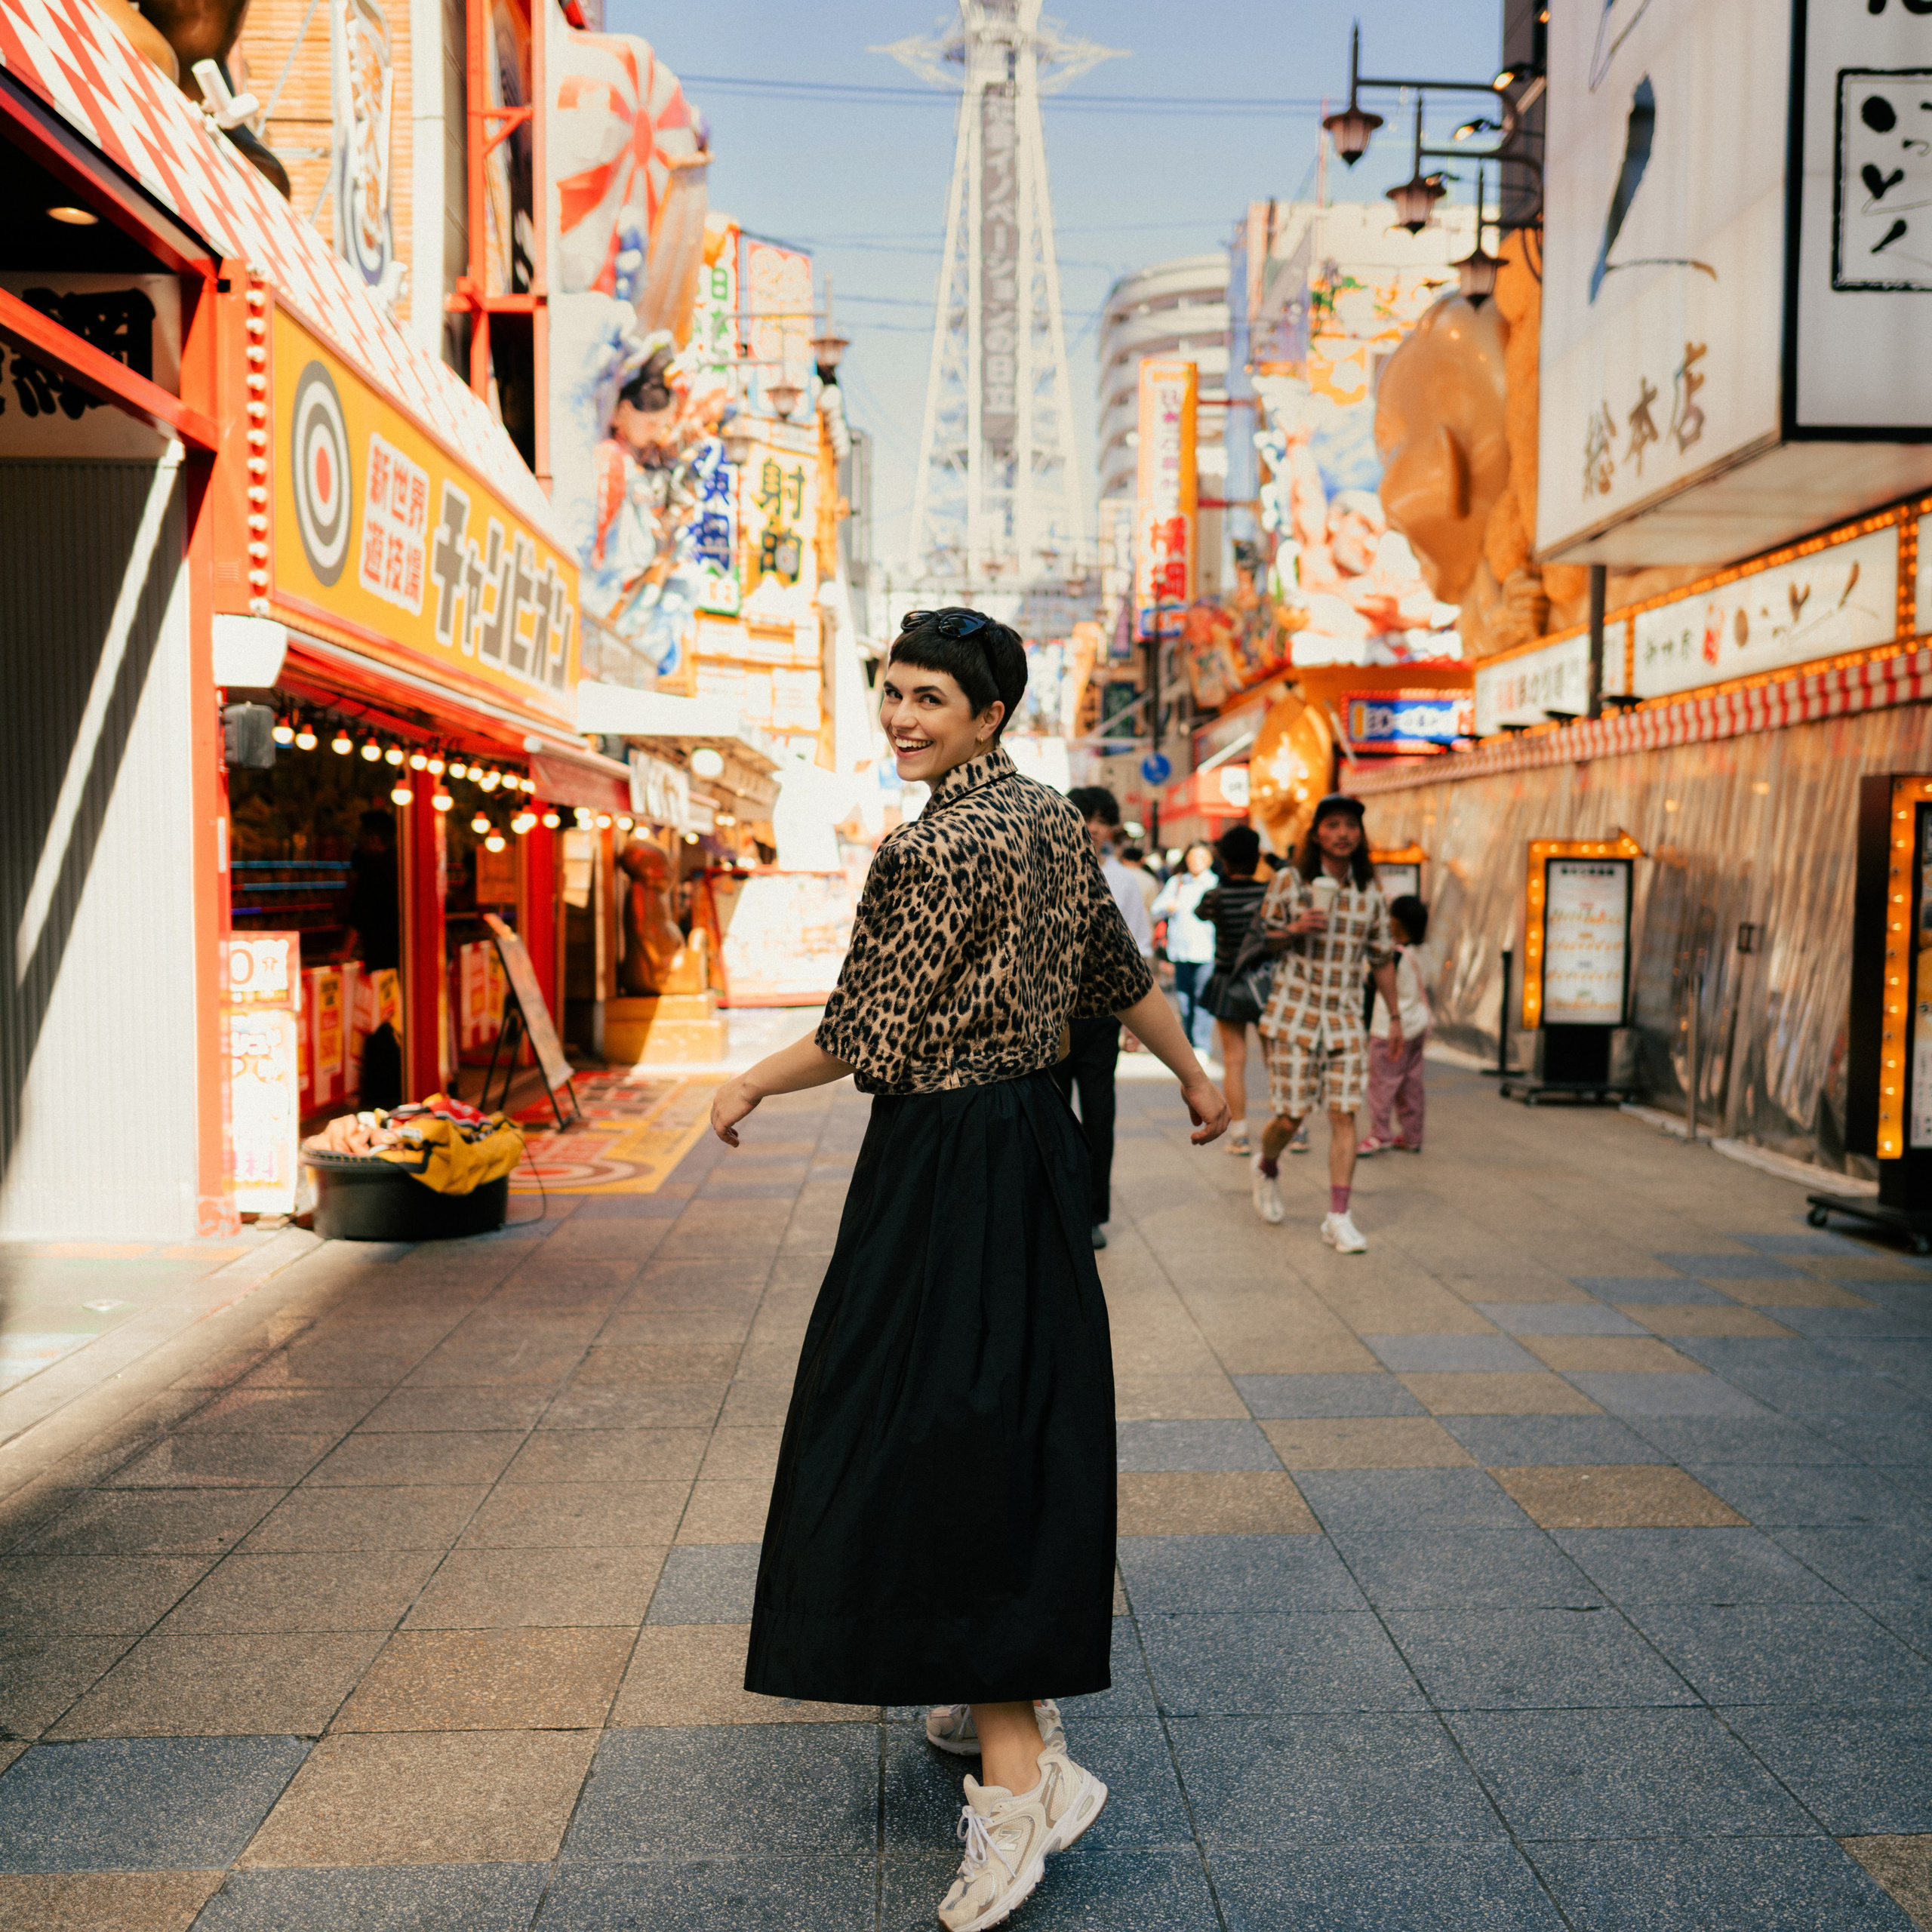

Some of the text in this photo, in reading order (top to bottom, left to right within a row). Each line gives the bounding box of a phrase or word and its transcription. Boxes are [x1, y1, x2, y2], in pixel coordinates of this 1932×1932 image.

[369, 445, 426, 535] 新世界
[432, 484, 575, 694] チャンピオン
[996, 1829, 1022, 1851] N
